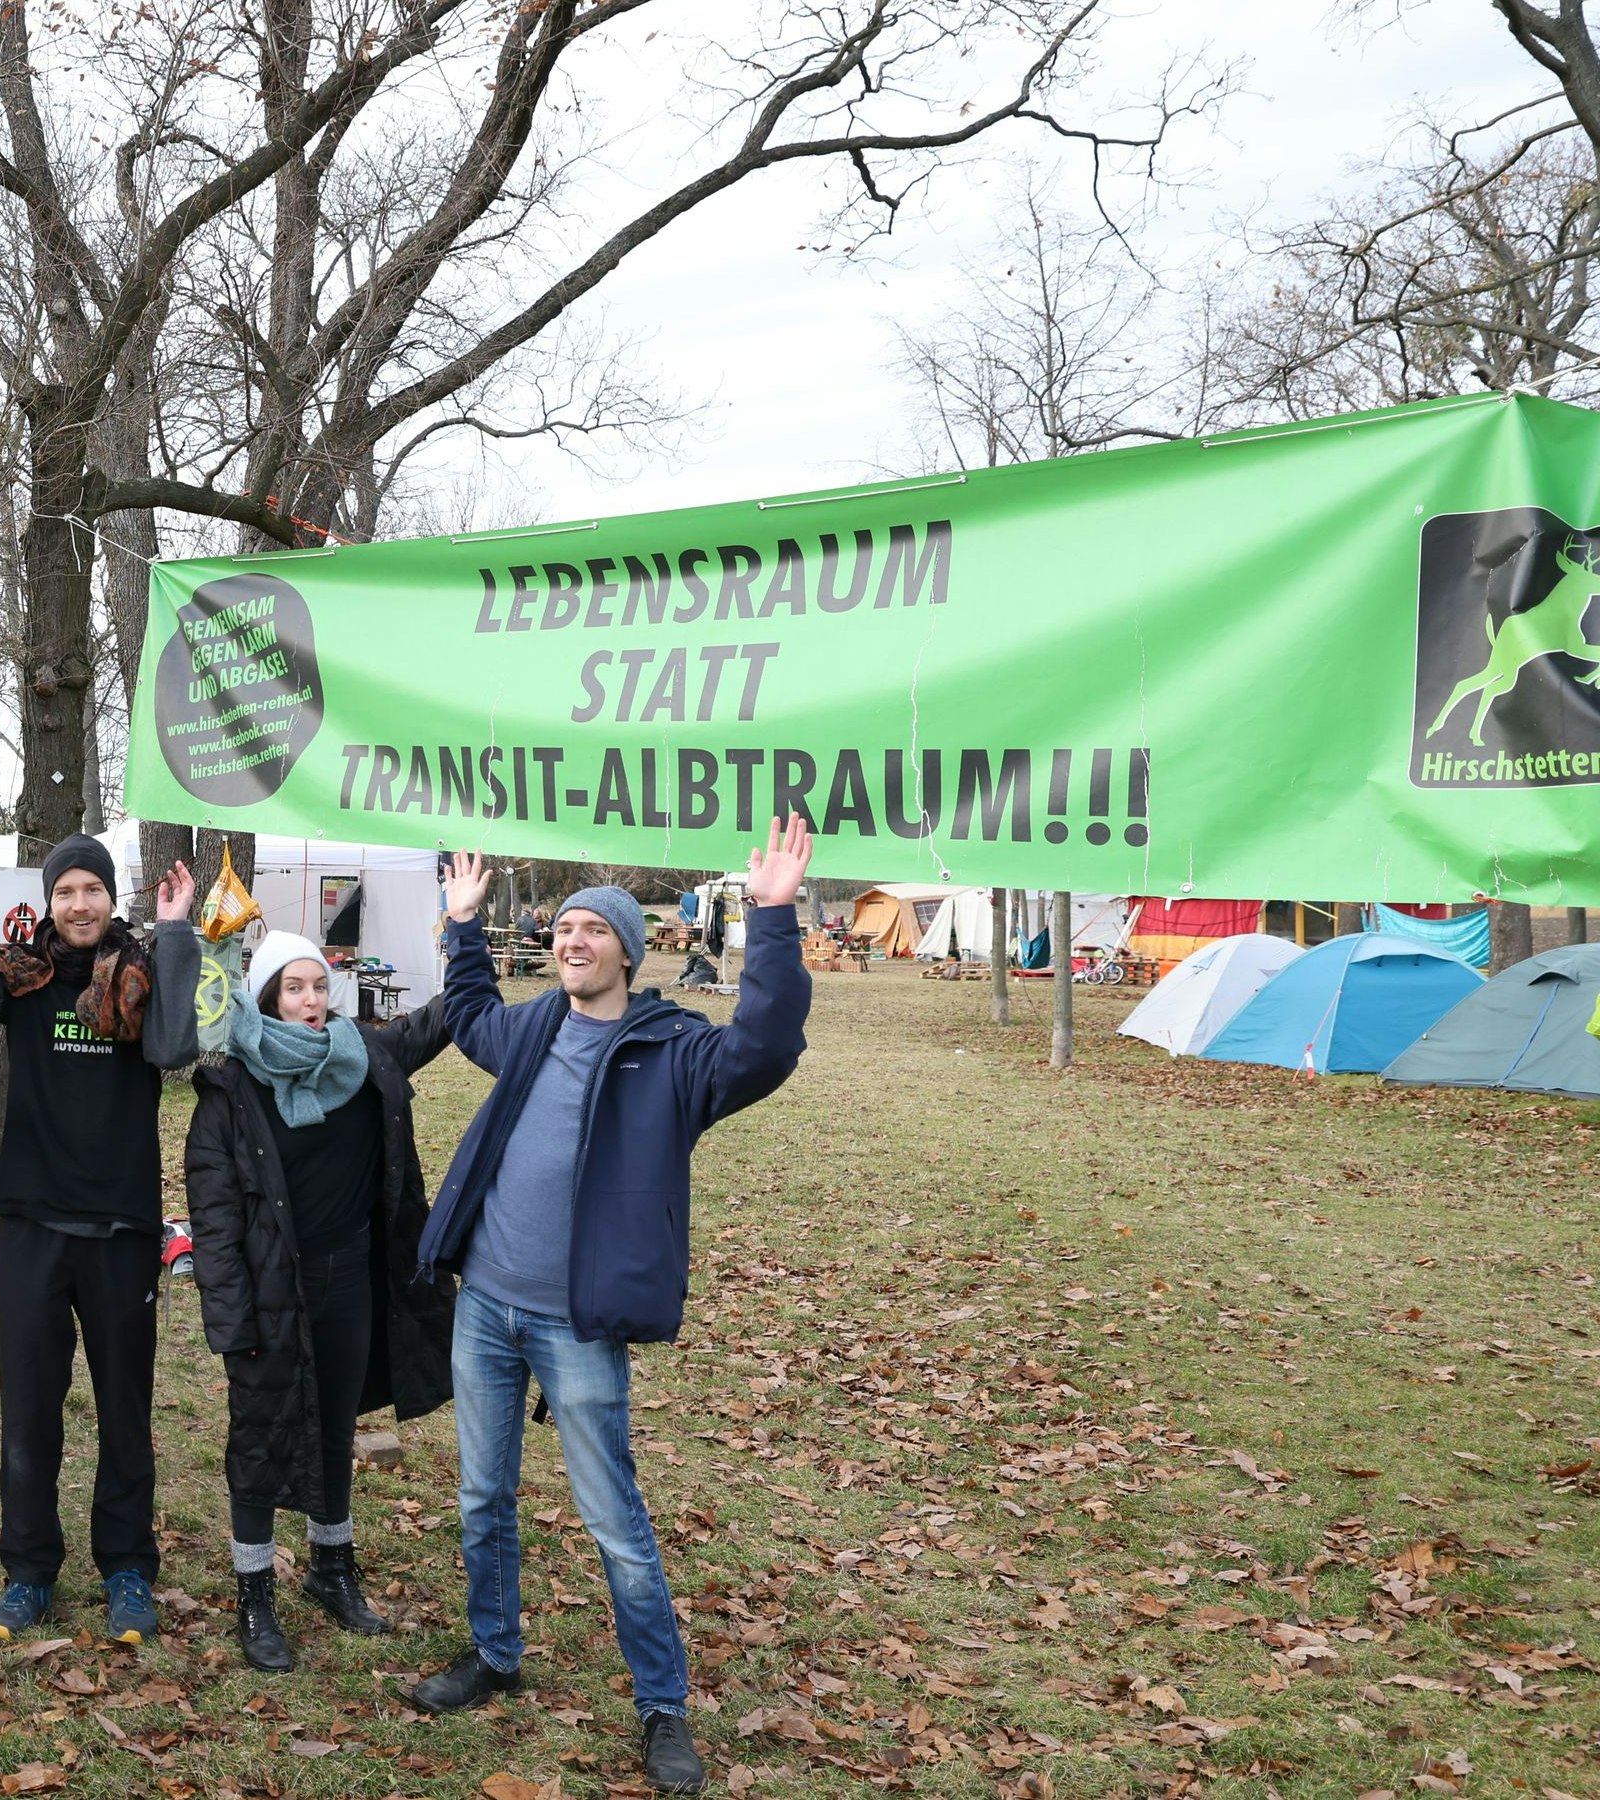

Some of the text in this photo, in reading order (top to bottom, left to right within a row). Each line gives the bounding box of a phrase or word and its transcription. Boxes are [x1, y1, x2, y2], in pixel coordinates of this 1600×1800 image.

[474, 520, 952, 633] LEBENSRAUM
[183, 595, 276, 643] GEMEINSAM
[192, 621, 278, 674] GEGEN LÄRM
[188, 650, 289, 704] UND ABGASE!
[570, 642, 780, 722] STATT
[167, 684, 313, 737] www.hirschstetten-retten.at
[188, 714, 295, 756] www.facebook.com/
[191, 742, 290, 779] hirschstetten.retten
[339, 744, 1151, 847] TRANSIT-ALBTRAUM!!!
[56, 1011, 76, 1020] HIER
[53, 1042, 113, 1054] AUTOBAHN
